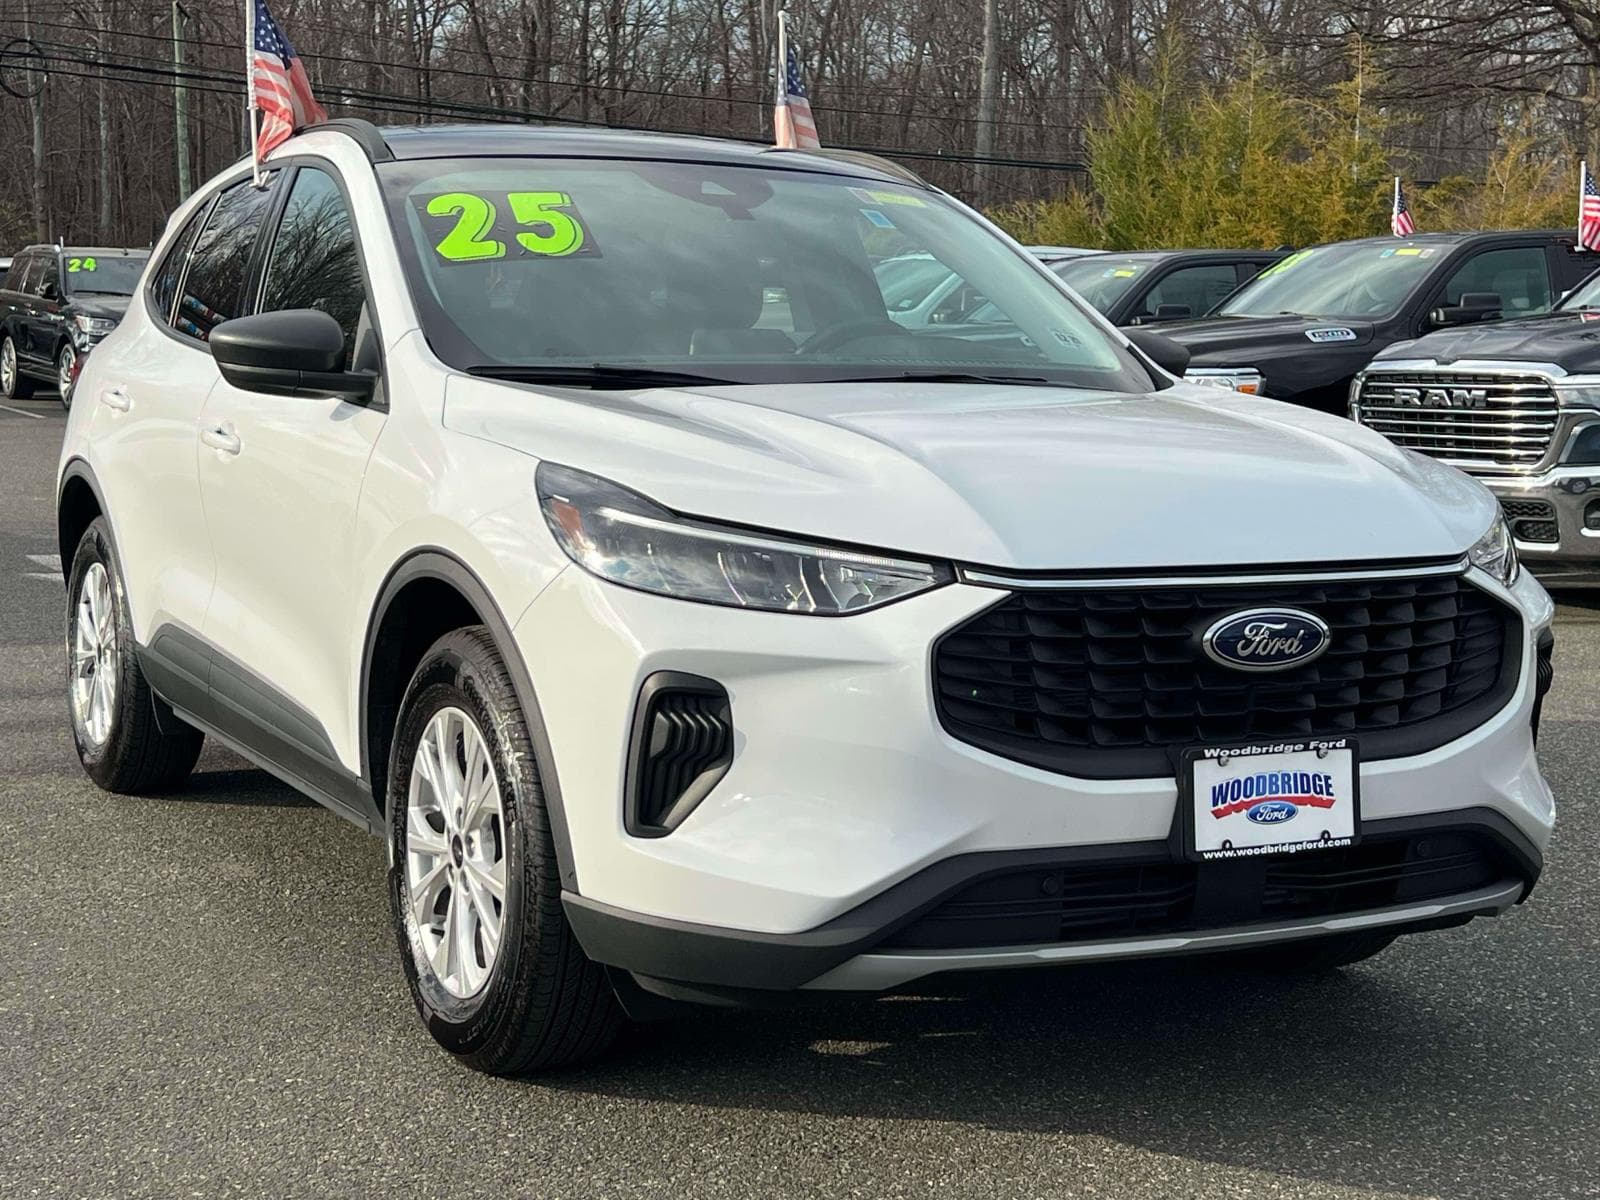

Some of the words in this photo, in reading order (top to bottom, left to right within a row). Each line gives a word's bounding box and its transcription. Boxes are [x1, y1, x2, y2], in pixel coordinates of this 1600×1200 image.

[427, 192, 585, 262] 25
[68, 257, 97, 273] 24
[1394, 388, 1487, 407] RAM
[1237, 622, 1304, 656] Ford
[1203, 743, 1304, 758] Woodbridge
[1309, 739, 1347, 750] Ford
[1211, 772, 1335, 808] WOODBRIDGE
[1256, 804, 1289, 821] Ford
[1203, 838, 1352, 860] www.woodbridgeford.com
